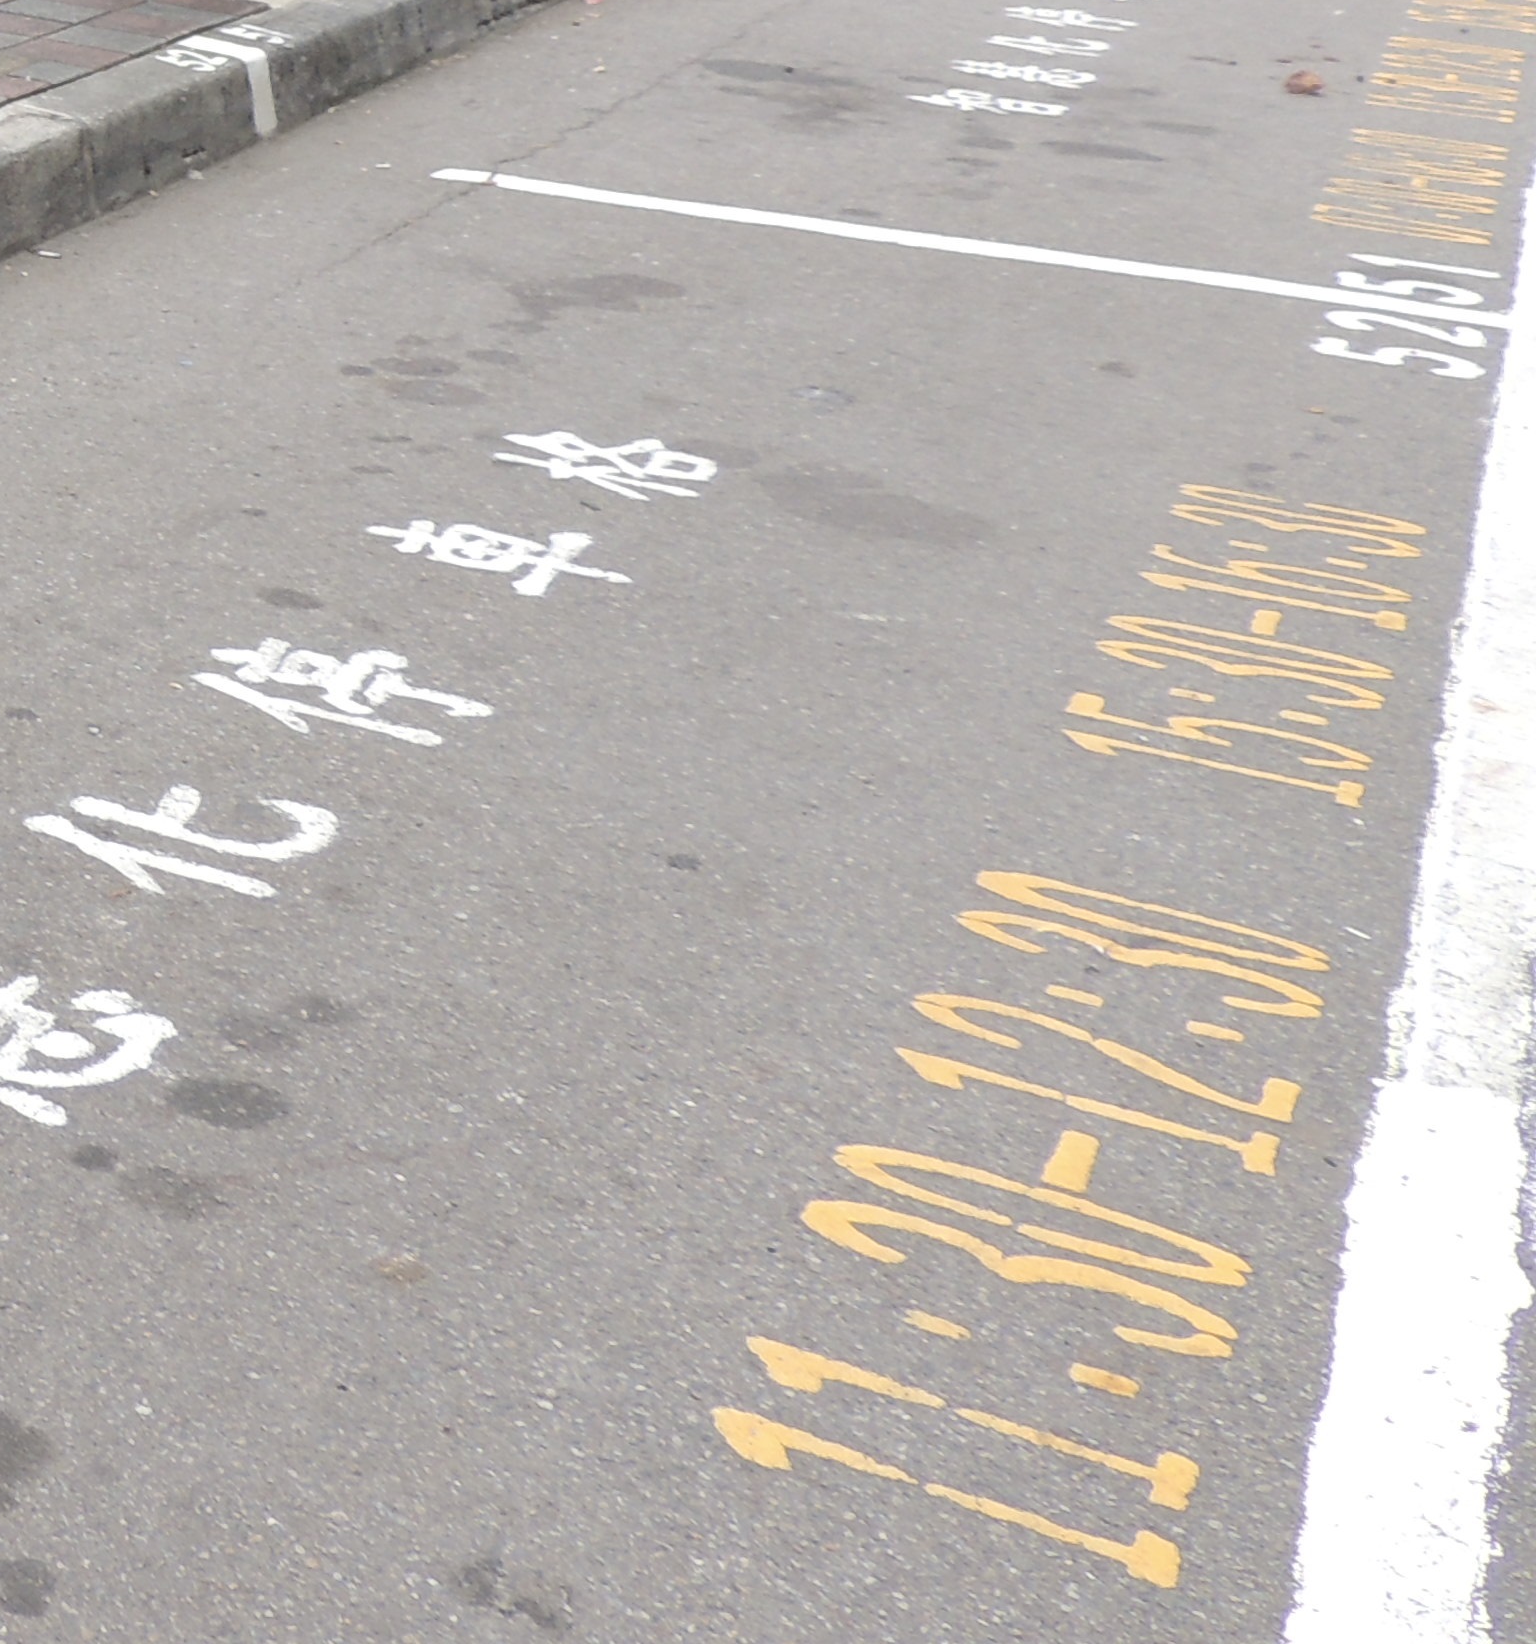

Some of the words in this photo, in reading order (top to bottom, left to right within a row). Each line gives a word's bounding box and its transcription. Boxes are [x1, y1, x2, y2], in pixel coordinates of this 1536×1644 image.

[1308, 309, 1488, 380] 52
[1334, 252, 1503, 306] 51
[1061, 482, 1428, 807] 15:30-16:30
[711, 869, 1330, 1590] 11:30-12:30
